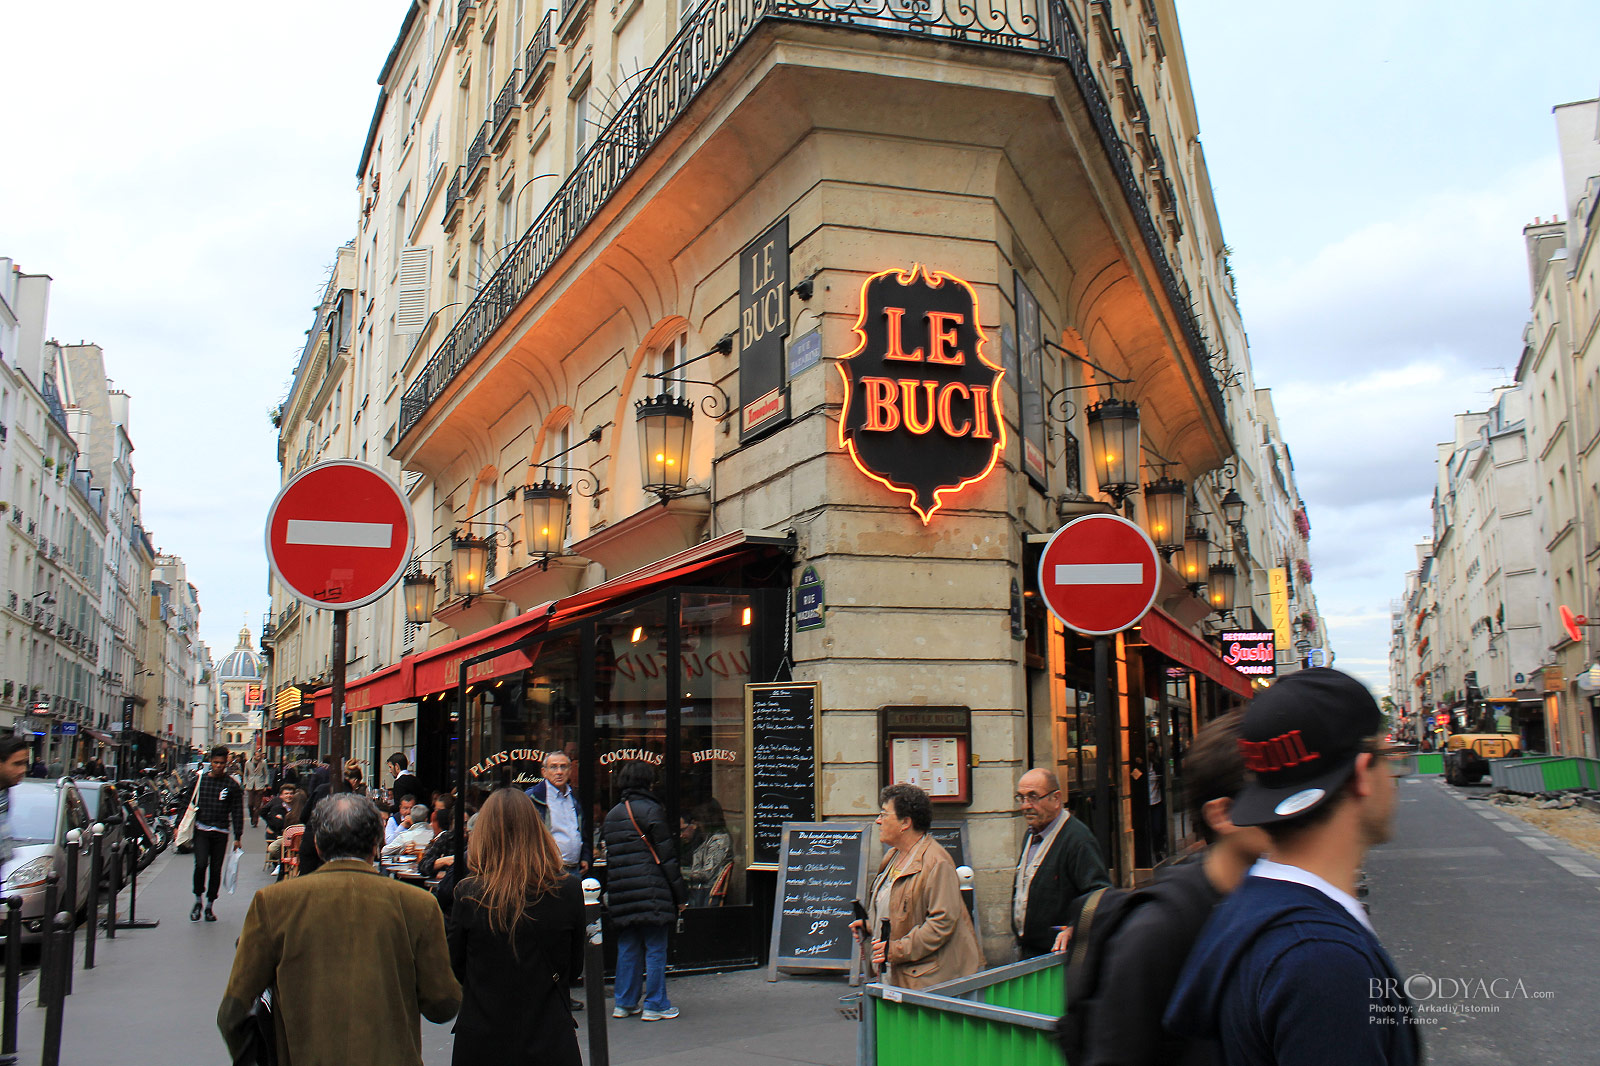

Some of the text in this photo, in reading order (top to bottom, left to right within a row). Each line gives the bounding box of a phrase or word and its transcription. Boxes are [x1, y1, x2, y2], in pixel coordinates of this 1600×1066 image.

[752, 240, 775, 295] LE
[742, 281, 786, 351] BUCI
[882, 306, 966, 366] LE
[859, 376, 992, 439] BUCI
[803, 594, 816, 605] RUE
[1273, 574, 1287, 644] PIZZA
[1222, 632, 1274, 641] RESTAURANT
[1223, 642, 1274, 665] Sushi
[469, 750, 508, 778] PLATS
[600, 748, 664, 766] COCKTAILS
[691, 748, 737, 763] BIERES
